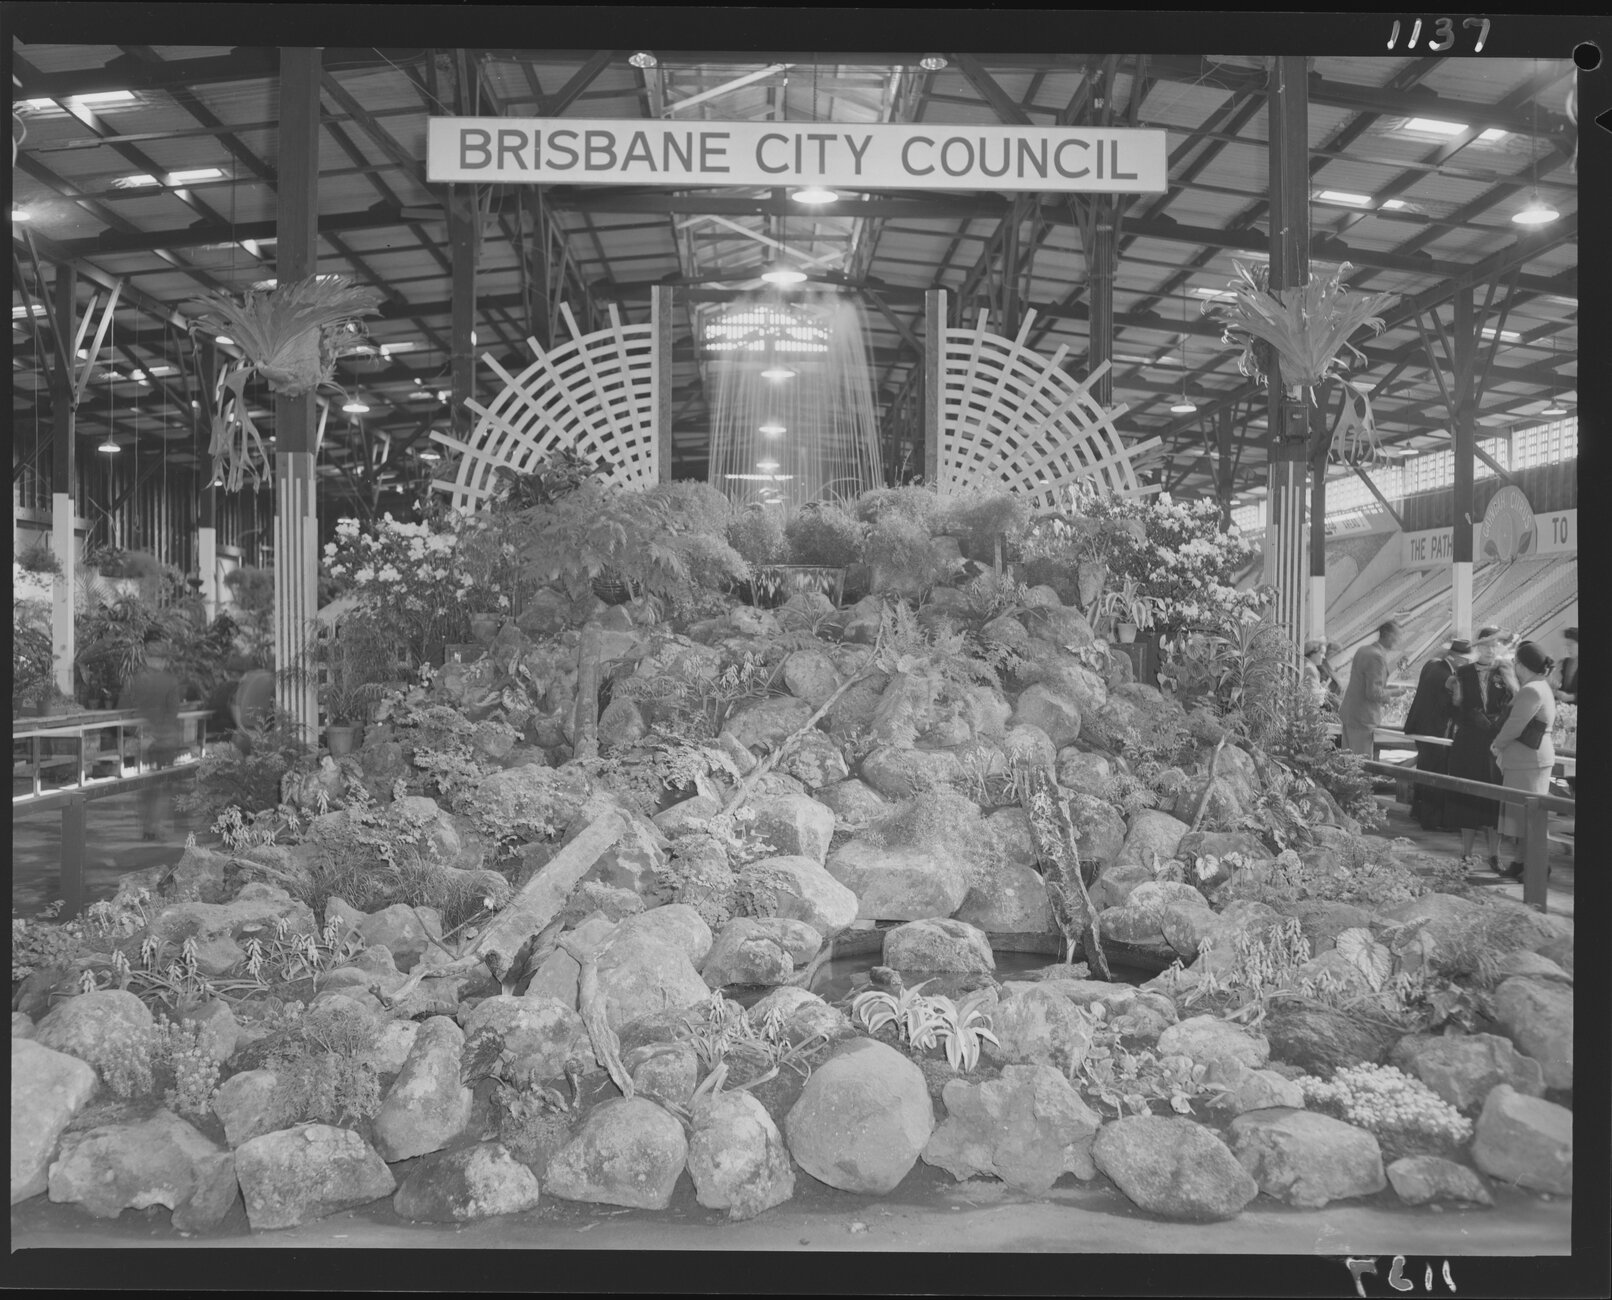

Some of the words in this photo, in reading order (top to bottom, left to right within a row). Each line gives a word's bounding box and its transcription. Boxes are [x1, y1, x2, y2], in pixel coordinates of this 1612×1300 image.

[1387, 17, 1491, 53] 1137
[459, 128, 731, 174] BRISBANE
[754, 132, 873, 176] CITY
[901, 136, 1138, 180] COUNCIL
[1510, 490, 1532, 530] CITRUS
[1410, 536, 1426, 562] THE
[1430, 533, 1453, 560] PATH
[1551, 516, 1568, 545] TO
